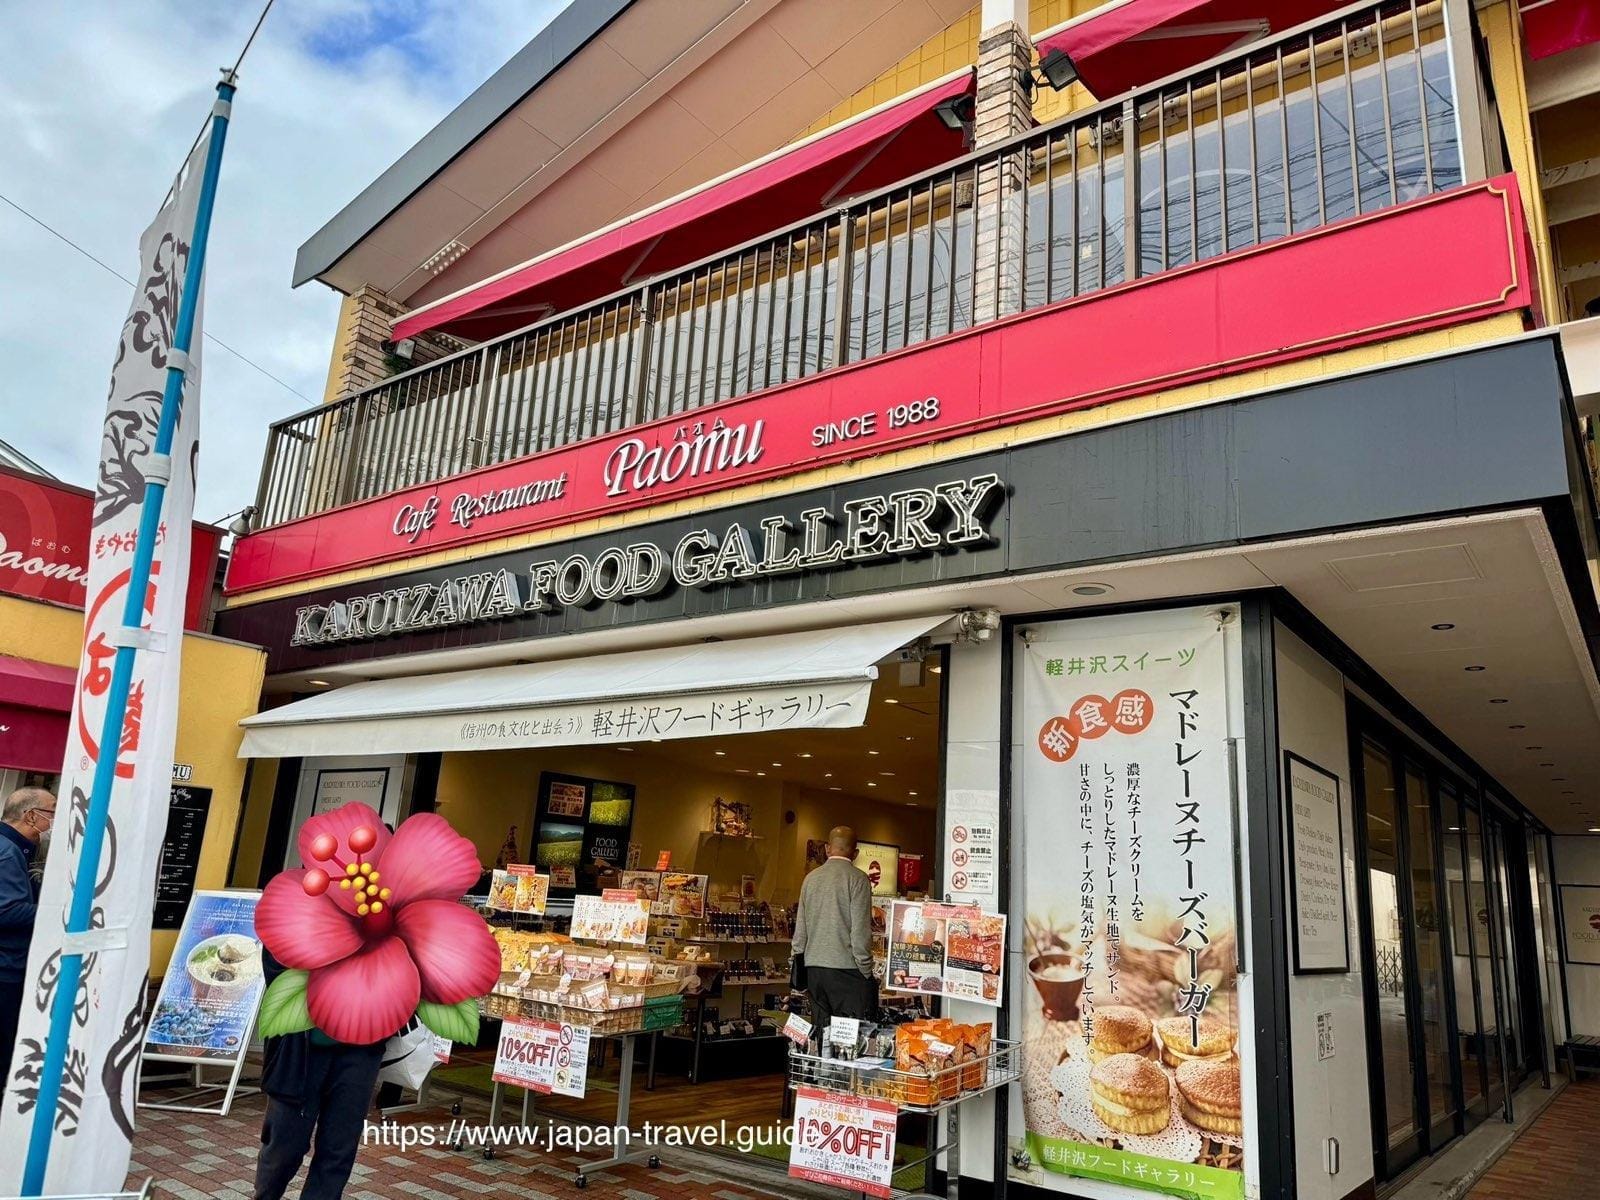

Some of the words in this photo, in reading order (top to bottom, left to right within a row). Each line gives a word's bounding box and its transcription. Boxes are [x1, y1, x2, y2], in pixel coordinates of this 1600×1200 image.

[393, 495, 441, 543] Café
[451, 472, 568, 527] Restaurant
[604, 419, 765, 497] Paomu
[812, 412, 876, 447] SINCE
[887, 397, 940, 427] 1988
[673, 416, 726, 441] パオム
[0, 532, 89, 586] aom
[290, 568, 516, 647] KARUIZAWA
[525, 545, 664, 611] FOOD
[673, 473, 1000, 587] GALLERY
[1045, 648, 1196, 676] 軽井沢スイーツ
[591, 693, 852, 739] 軽井沢フードギャラリー
[1042, 694, 1147, 757] 新食感
[1103, 762, 1120, 1003] しっとりしたマドレーヌ生地でサンド。
[1126, 762, 1145, 922] 濃厚なチーズクリームを
[1169, 688, 1211, 1048] マドレーヌチーズバーガー
[1079, 762, 1095, 1055] 甘さの中に、チーズの塩気がマッチしています。
[1042, 1143, 1216, 1188] 軽井沢フードギャラリー
